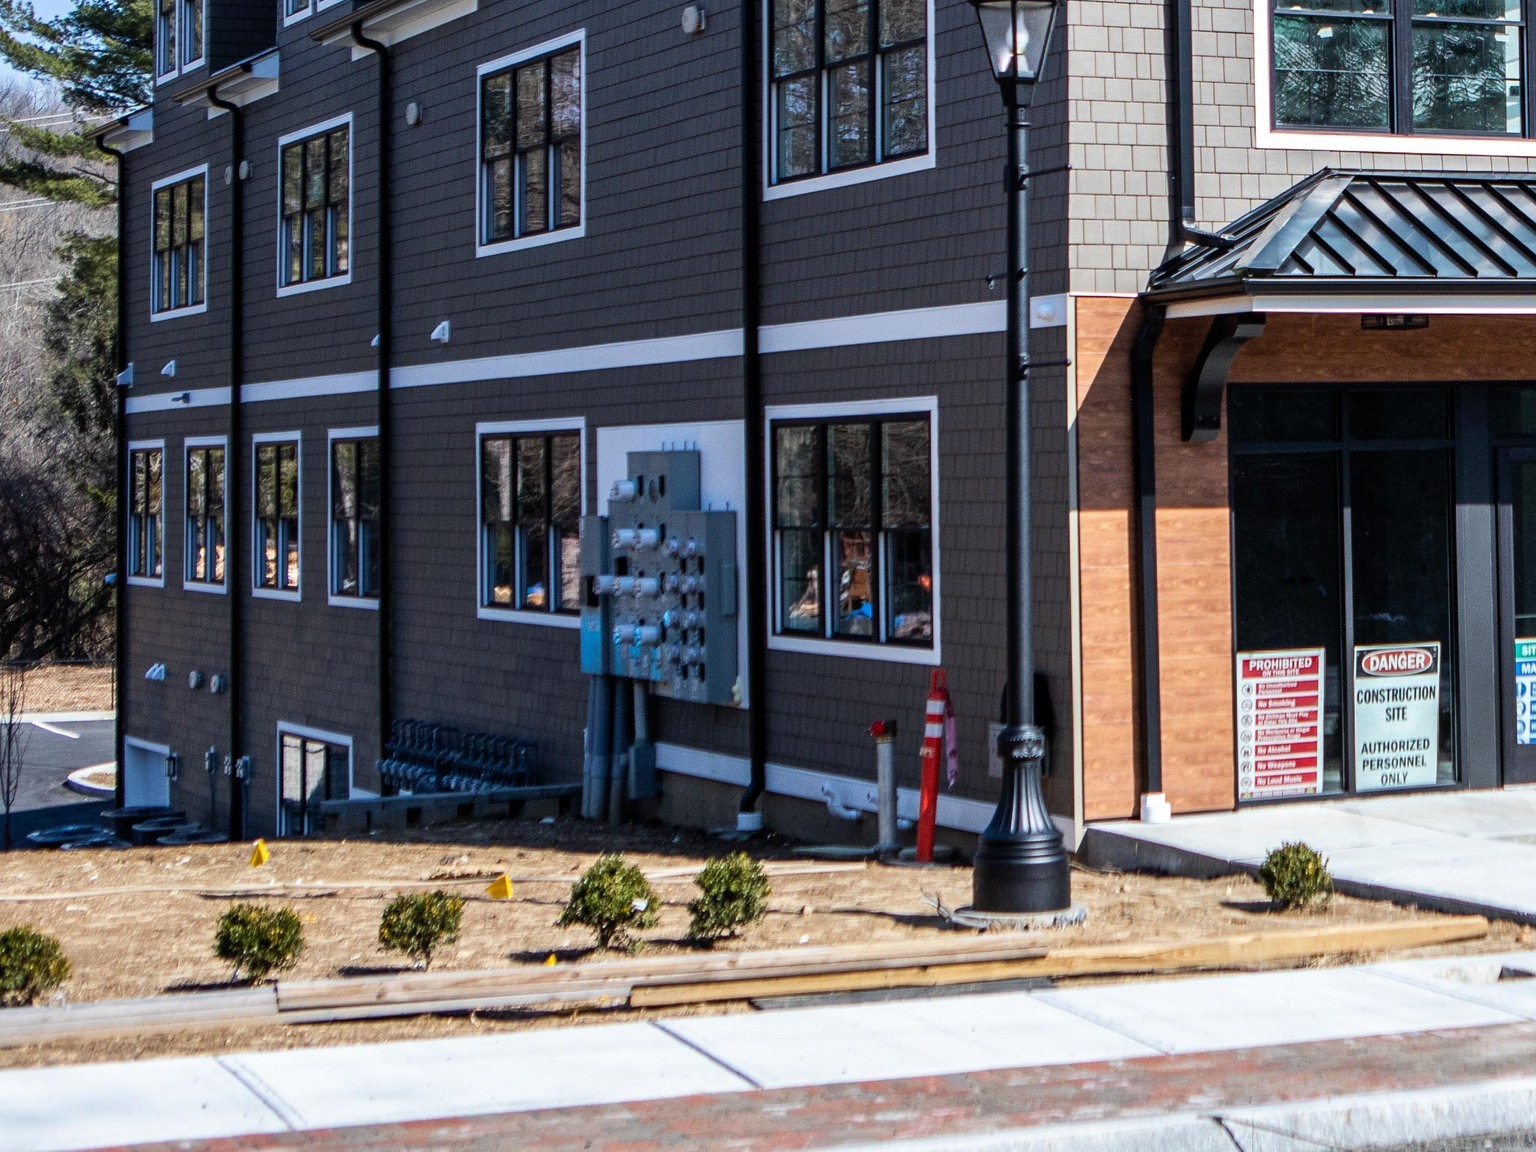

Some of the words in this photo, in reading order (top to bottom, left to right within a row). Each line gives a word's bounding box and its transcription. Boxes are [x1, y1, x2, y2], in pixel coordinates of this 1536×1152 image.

[1249, 657, 1312, 672] PROHIBITED
[1369, 652, 1425, 672] DANGER
[1258, 700, 1267, 708] No
[1268, 698, 1296, 708] Smoking
[1356, 686, 1436, 705] CONSTRUCTION
[1385, 706, 1408, 722] SITE
[1257, 747, 1266, 755] No
[1268, 744, 1291, 754] Alcohol
[1361, 738, 1430, 755] AUTHORIZED
[1257, 762, 1266, 770] No
[1268, 761, 1296, 770] Weapons
[1362, 754, 1427, 772] PERSONNEL
[1257, 778, 1266, 786] No
[1267, 776, 1283, 785] Loud
[1283, 775, 1303, 784] Music
[1380, 772, 1408, 786] ONLY
